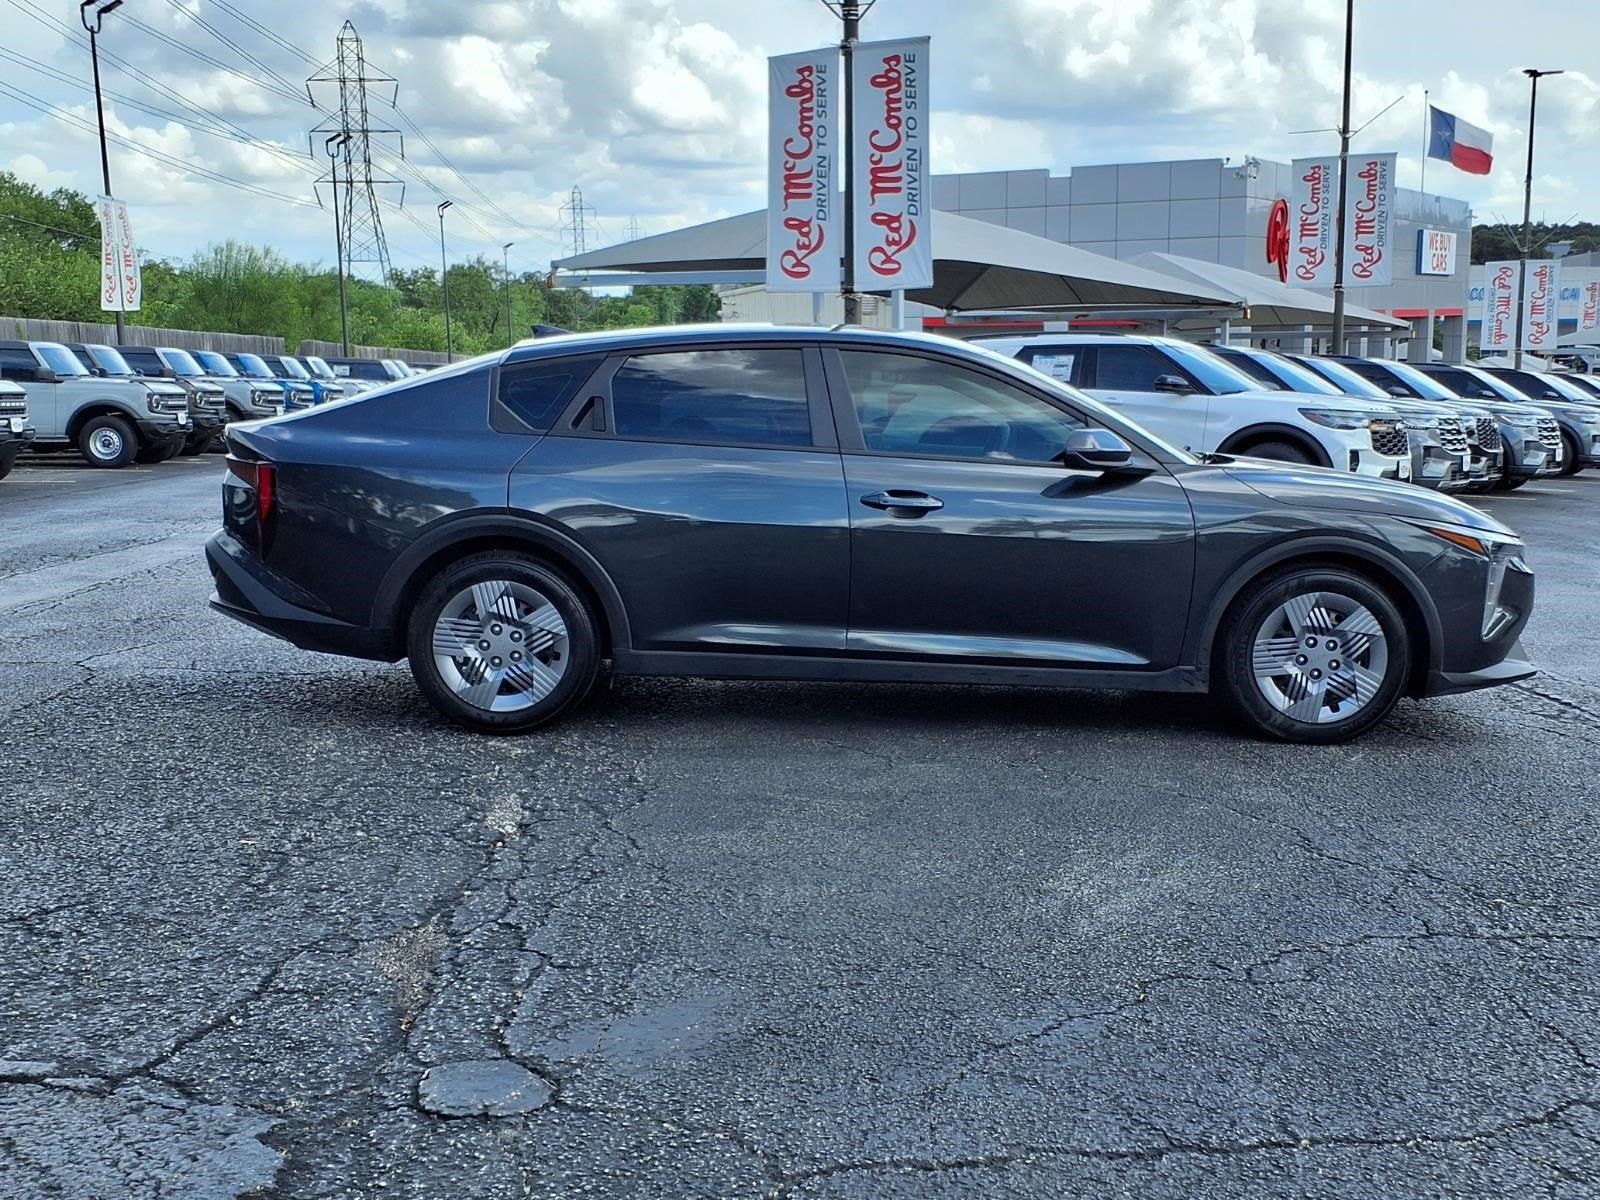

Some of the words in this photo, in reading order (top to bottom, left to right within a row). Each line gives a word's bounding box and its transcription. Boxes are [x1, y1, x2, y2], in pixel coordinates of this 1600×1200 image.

[816, 64, 827, 118] SERVE
[905, 52, 916, 111] SERVE
[783, 65, 814, 212] McCombs
[816, 124, 828, 148] TO
[868, 54, 903, 207] McCombs
[906, 116, 917, 142] TO
[816, 155, 828, 222] DRIVEN
[906, 147, 918, 217] DRIVEN
[1380, 160, 1388, 191] SERVE
[1298, 164, 1322, 244] McCombs
[1322, 197, 1330, 210] TO
[1354, 160, 1378, 242] McCombs
[1378, 193, 1386, 207] TO
[780, 216, 825, 279] Red
[867, 211, 917, 276] Red
[1320, 213, 1330, 250] DRIVEN
[1377, 210, 1387, 248] DRIVEN
[1428, 232, 1439, 251] WE
[1440, 233, 1452, 252] BUY
[1295, 246, 1325, 281] Red
[1351, 244, 1382, 279] Red
[1431, 252, 1448, 272] CARS
[1492, 266, 1514, 290] Red
[1529, 264, 1548, 319] McCombs
[1494, 291, 1512, 345] McCombs
[1527, 320, 1550, 345] Red
